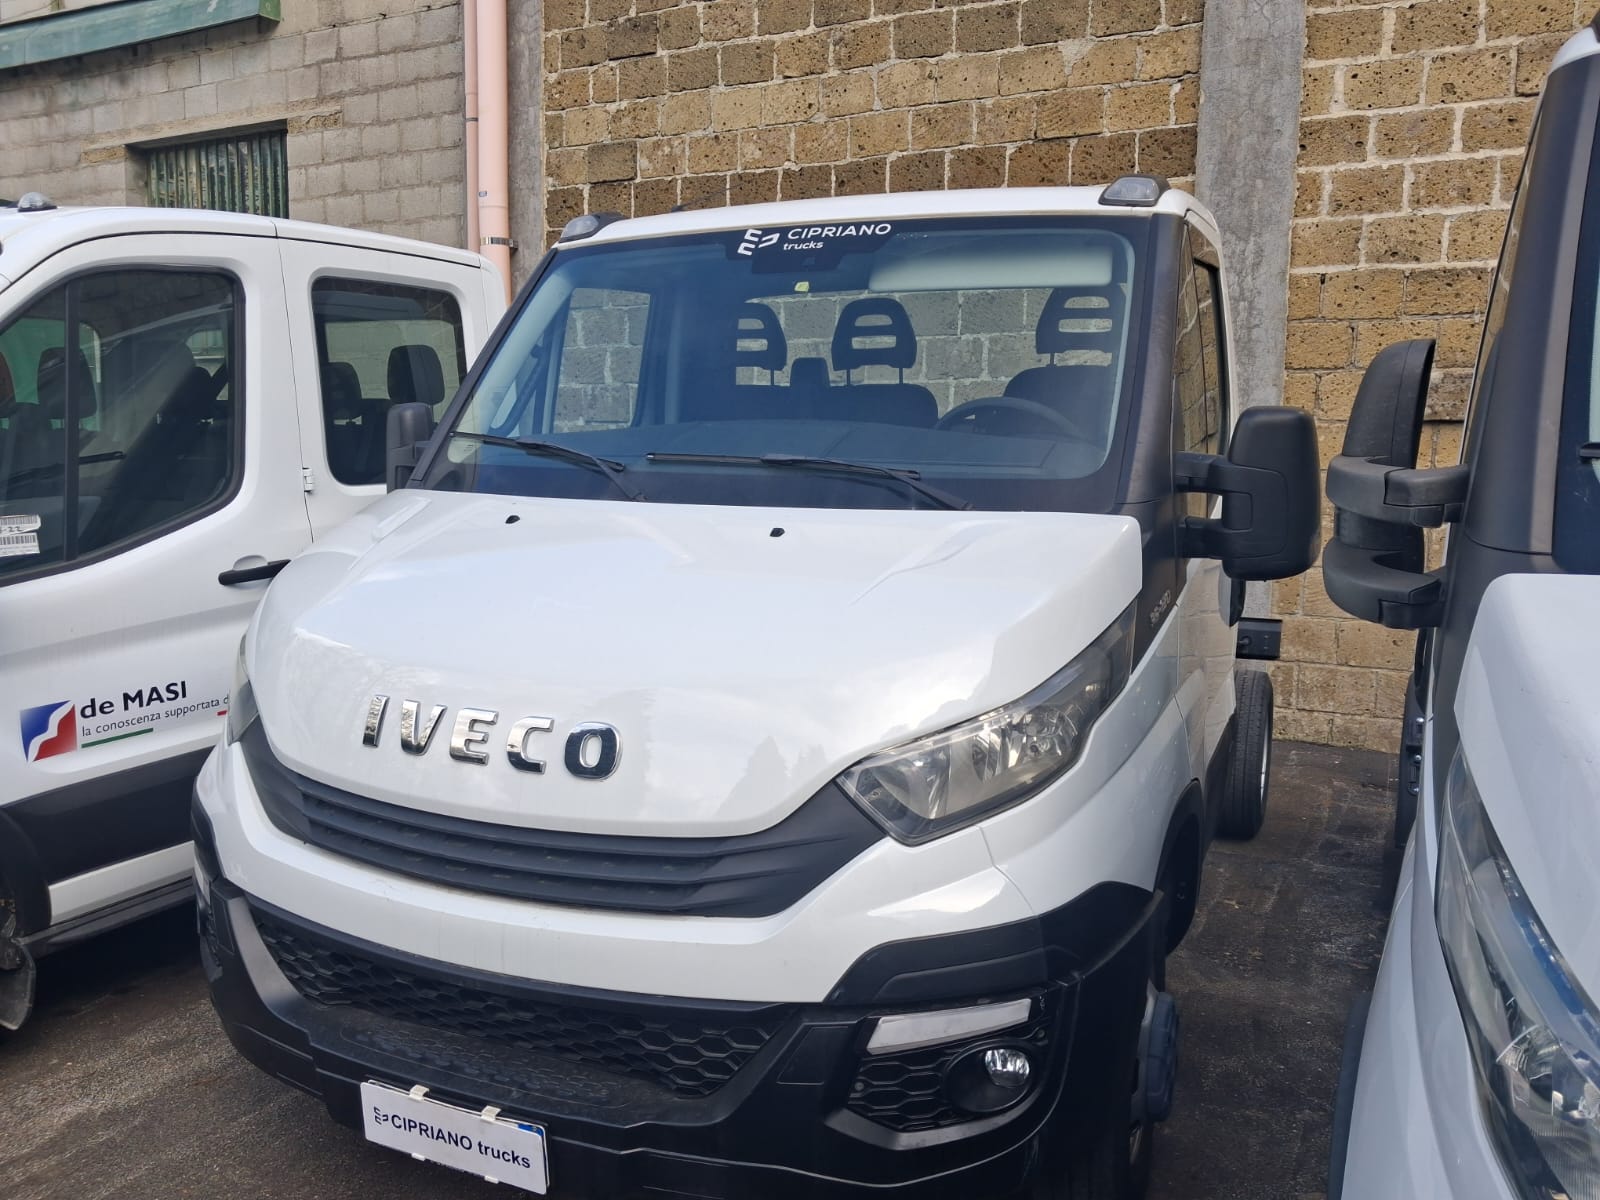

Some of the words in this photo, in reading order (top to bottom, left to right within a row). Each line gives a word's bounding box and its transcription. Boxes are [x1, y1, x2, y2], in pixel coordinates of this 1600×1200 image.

[783, 241, 823, 251] trucks
[787, 223, 891, 240] CIPRIANO
[80, 697, 114, 719] de
[123, 680, 187, 711] MASI
[82, 726, 91, 737] la
[96, 712, 161, 734] conoscenza
[164, 698, 220, 720] supportata
[362, 694, 623, 781] IVECO
[391, 1114, 473, 1151] CIPRIANO
[477, 1140, 531, 1169] trucks
